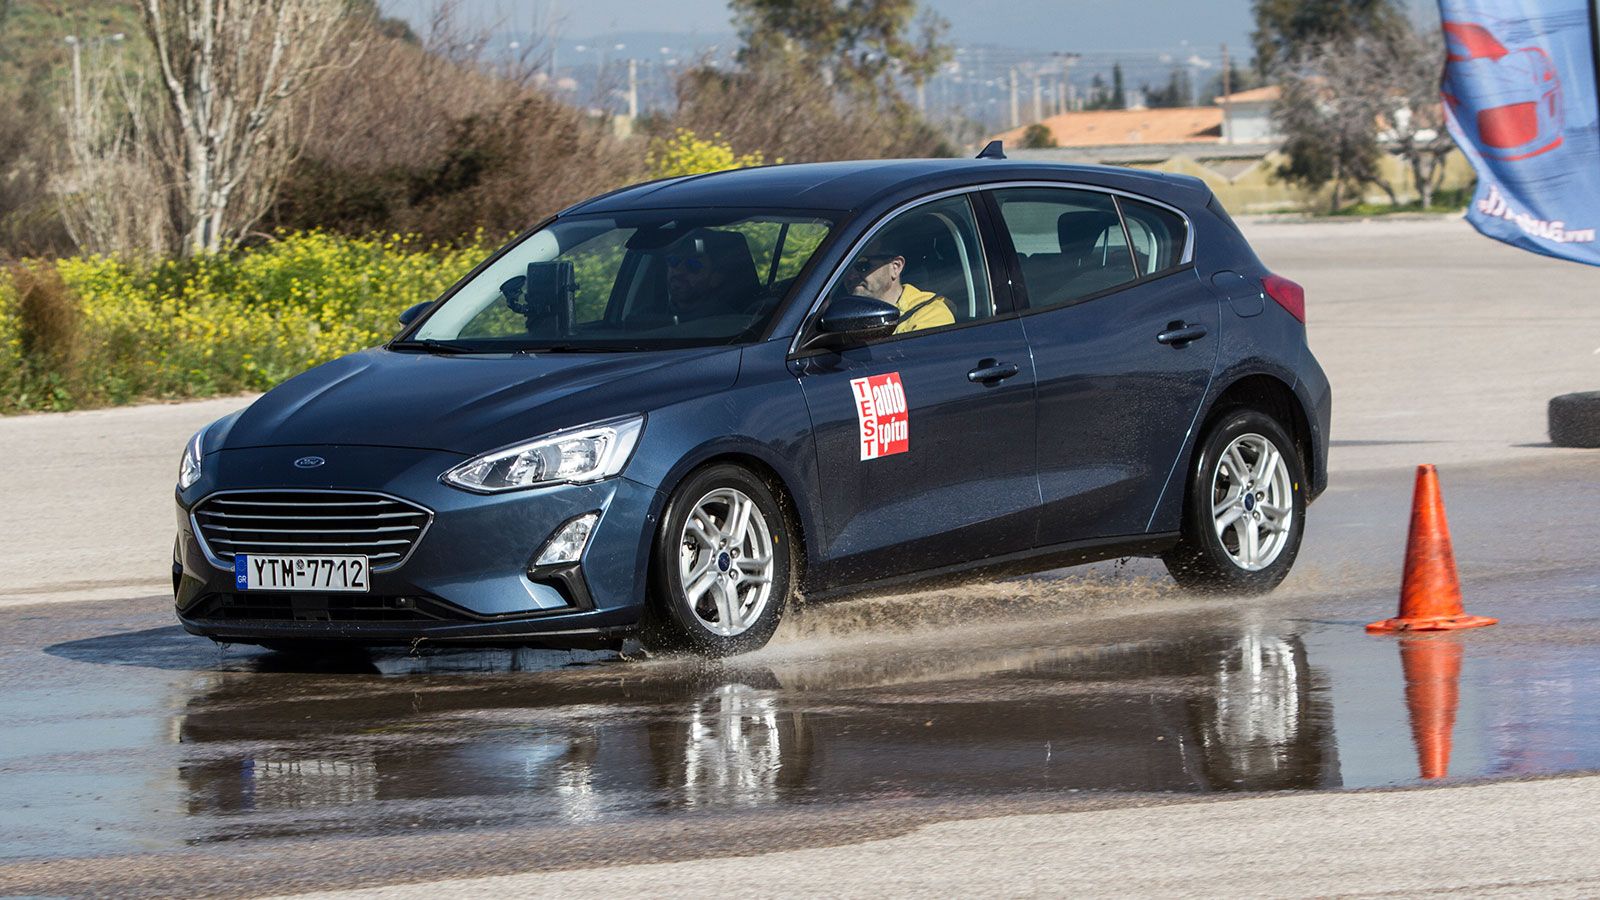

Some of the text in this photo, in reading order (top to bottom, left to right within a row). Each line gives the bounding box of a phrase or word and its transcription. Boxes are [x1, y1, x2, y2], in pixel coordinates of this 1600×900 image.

[872, 377, 906, 417] auto
[854, 381, 875, 456] TEST
[237, 575, 247, 584] GR
